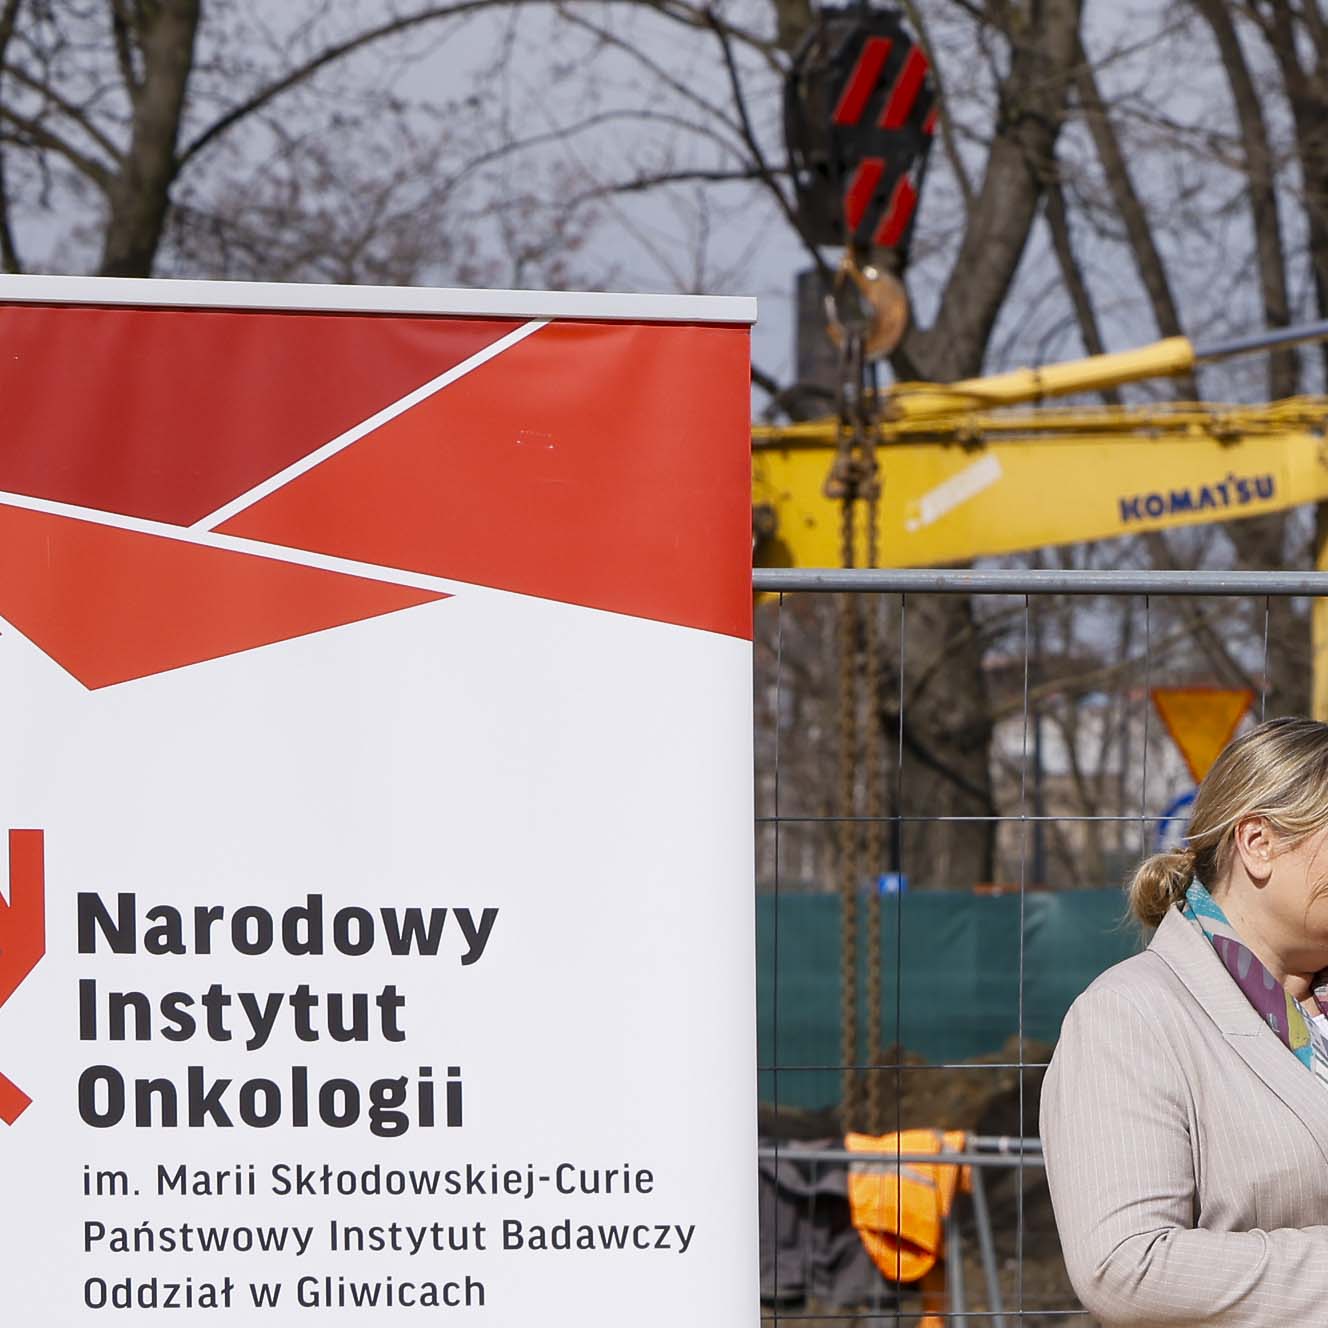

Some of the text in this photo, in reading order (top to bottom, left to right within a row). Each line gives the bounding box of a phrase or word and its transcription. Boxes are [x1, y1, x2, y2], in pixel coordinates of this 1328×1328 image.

[1119, 472, 1274, 522] KOMATSU
[77, 891, 500, 966] Narodowy
[78, 978, 406, 1052] Instytut
[77, 1064, 463, 1138] Onkologii
[83, 1162, 654, 1200] im. Marii Skłodowskiej-Curie
[84, 1218, 696, 1257] Państwowy Instytut Badawczy
[84, 1275, 485, 1309] Oddział w Gliwicach
